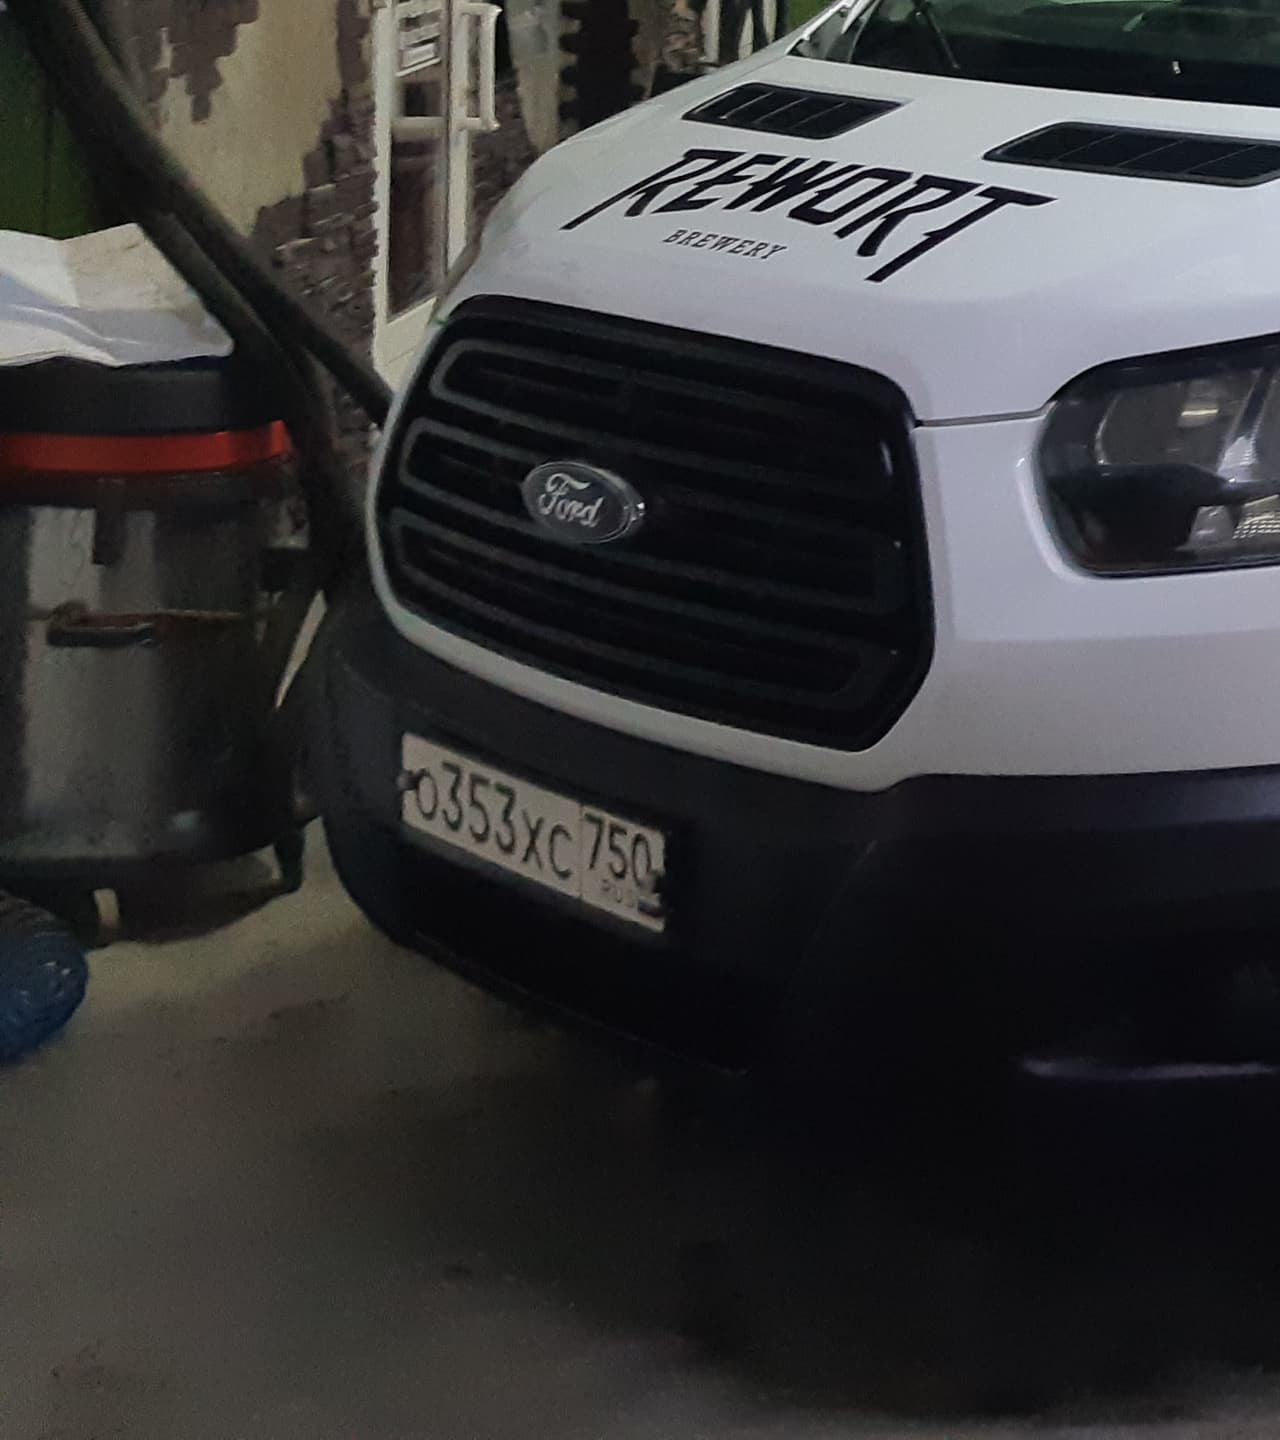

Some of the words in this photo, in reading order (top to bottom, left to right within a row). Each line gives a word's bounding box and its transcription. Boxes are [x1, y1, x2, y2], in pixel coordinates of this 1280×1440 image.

[560, 148, 1058, 282] REWORT
[662, 229, 788, 261] BREWERY
[538, 473, 606, 528] Ford
